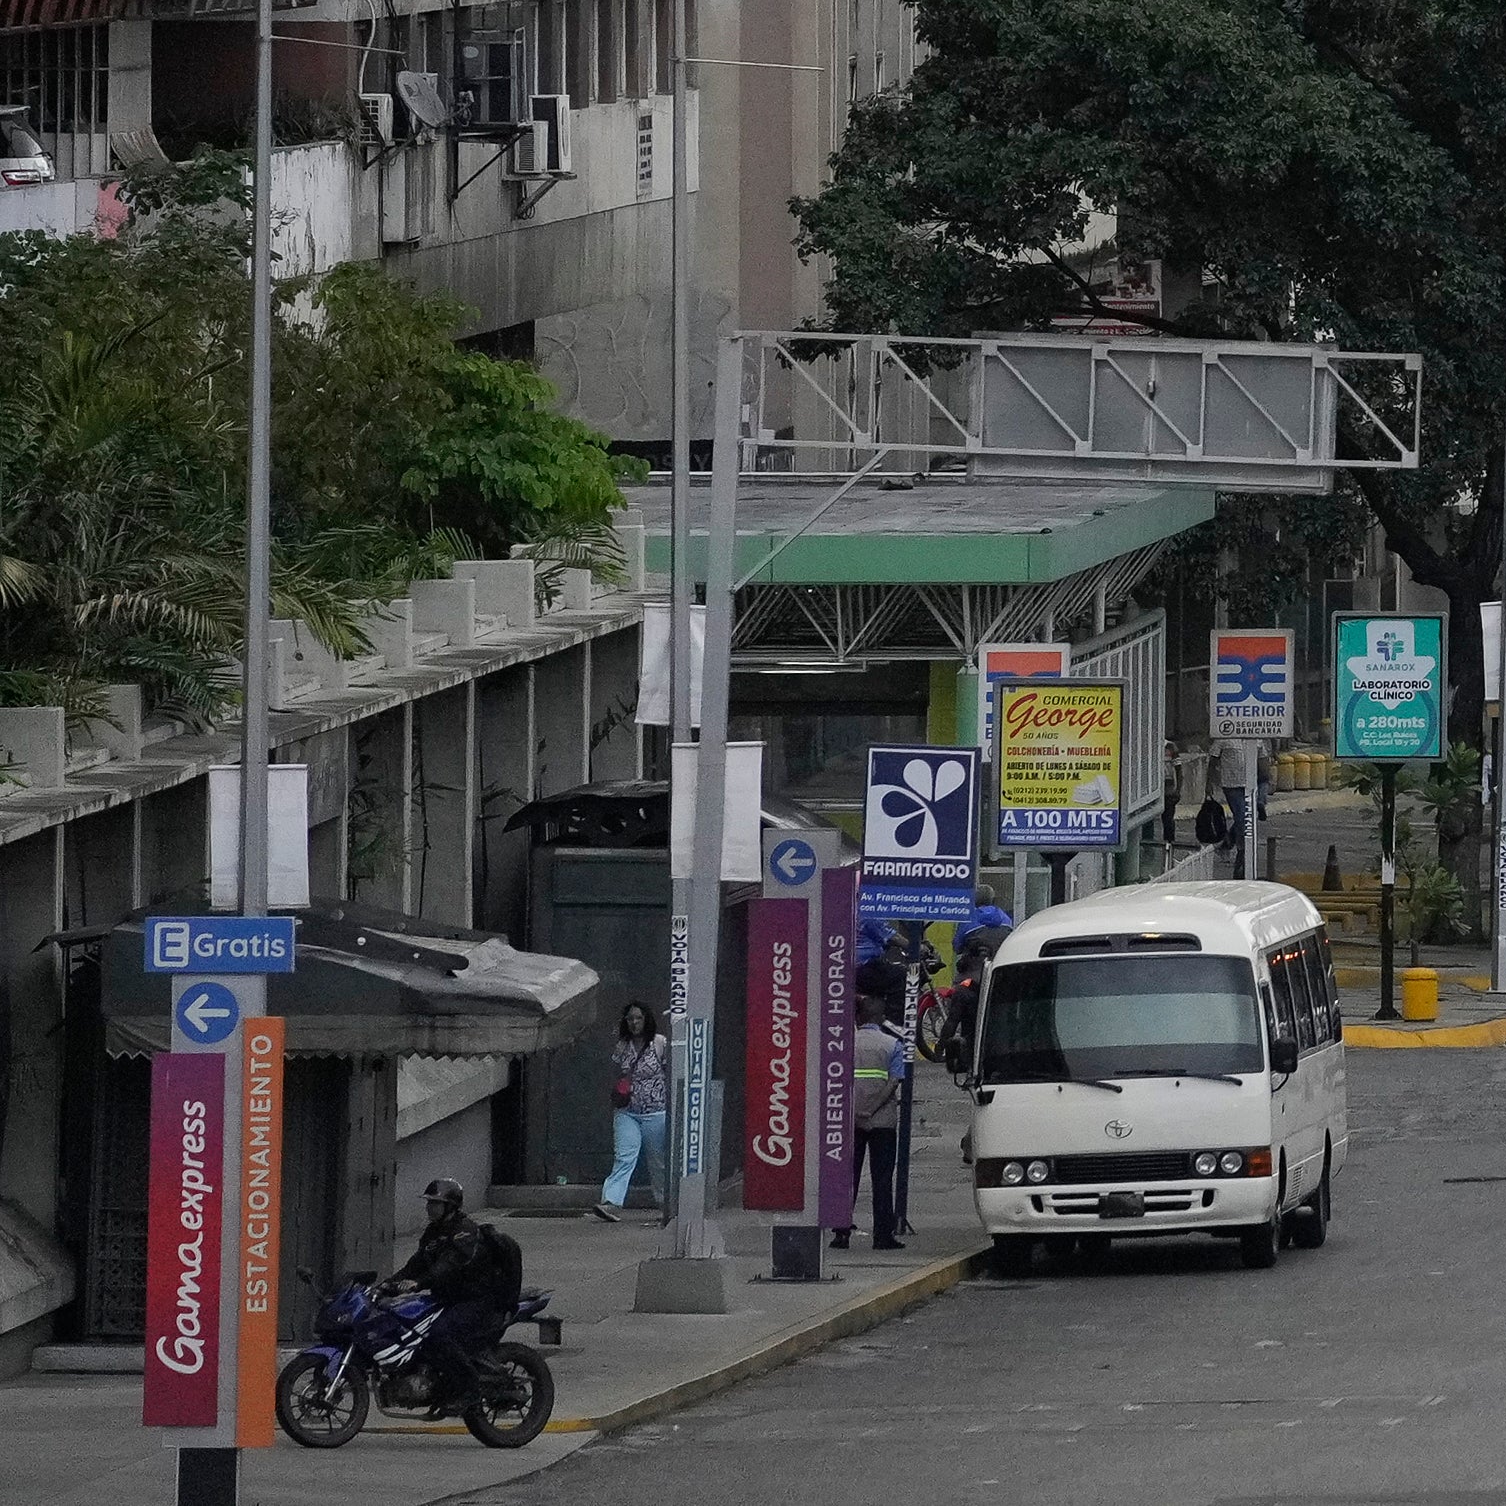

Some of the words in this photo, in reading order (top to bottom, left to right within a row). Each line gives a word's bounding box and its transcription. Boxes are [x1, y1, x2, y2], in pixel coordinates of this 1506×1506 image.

[1366, 663, 1416, 672] SANAROX
[1353, 680, 1430, 689] LABORATORIO
[1042, 695, 1113, 705] COMERCIAL
[1370, 689, 1413, 700] CLÍNICO
[1006, 693, 1114, 739] George
[1216, 705, 1285, 717] EXTERIOR
[1236, 720, 1283, 728] SEGURIDAD
[1236, 727, 1282, 735] BANCARIA
[1006, 744, 1060, 756] COLCHONERÍA
[1067, 744, 1112, 756] MUEBLERÍA
[1007, 761, 1034, 770] ABIERTO
[1046, 762, 1067, 771] LUNES
[1001, 810, 1018, 828] A
[1024, 810, 1062, 828] 100
[1067, 810, 1114, 828] MTS
[863, 860, 971, 880] FARMATODO
[860, 892, 874, 902] Av.
[876, 893, 920, 904] Francisco
[935, 895, 971, 904] Miranda
[891, 905, 927, 915] Principal
[193, 933, 286, 958] Gratis
[828, 935, 846, 1014] HORAS
[670, 968, 687, 1015] BLANCO
[827, 1024, 844, 1052] 24
[692, 1023, 703, 1077] VOTA
[826, 1061, 844, 1162] ABIERTO
[689, 1095, 701, 1159] CONDE
[246, 1034, 273, 1313] ESTACIONAMIENTO
